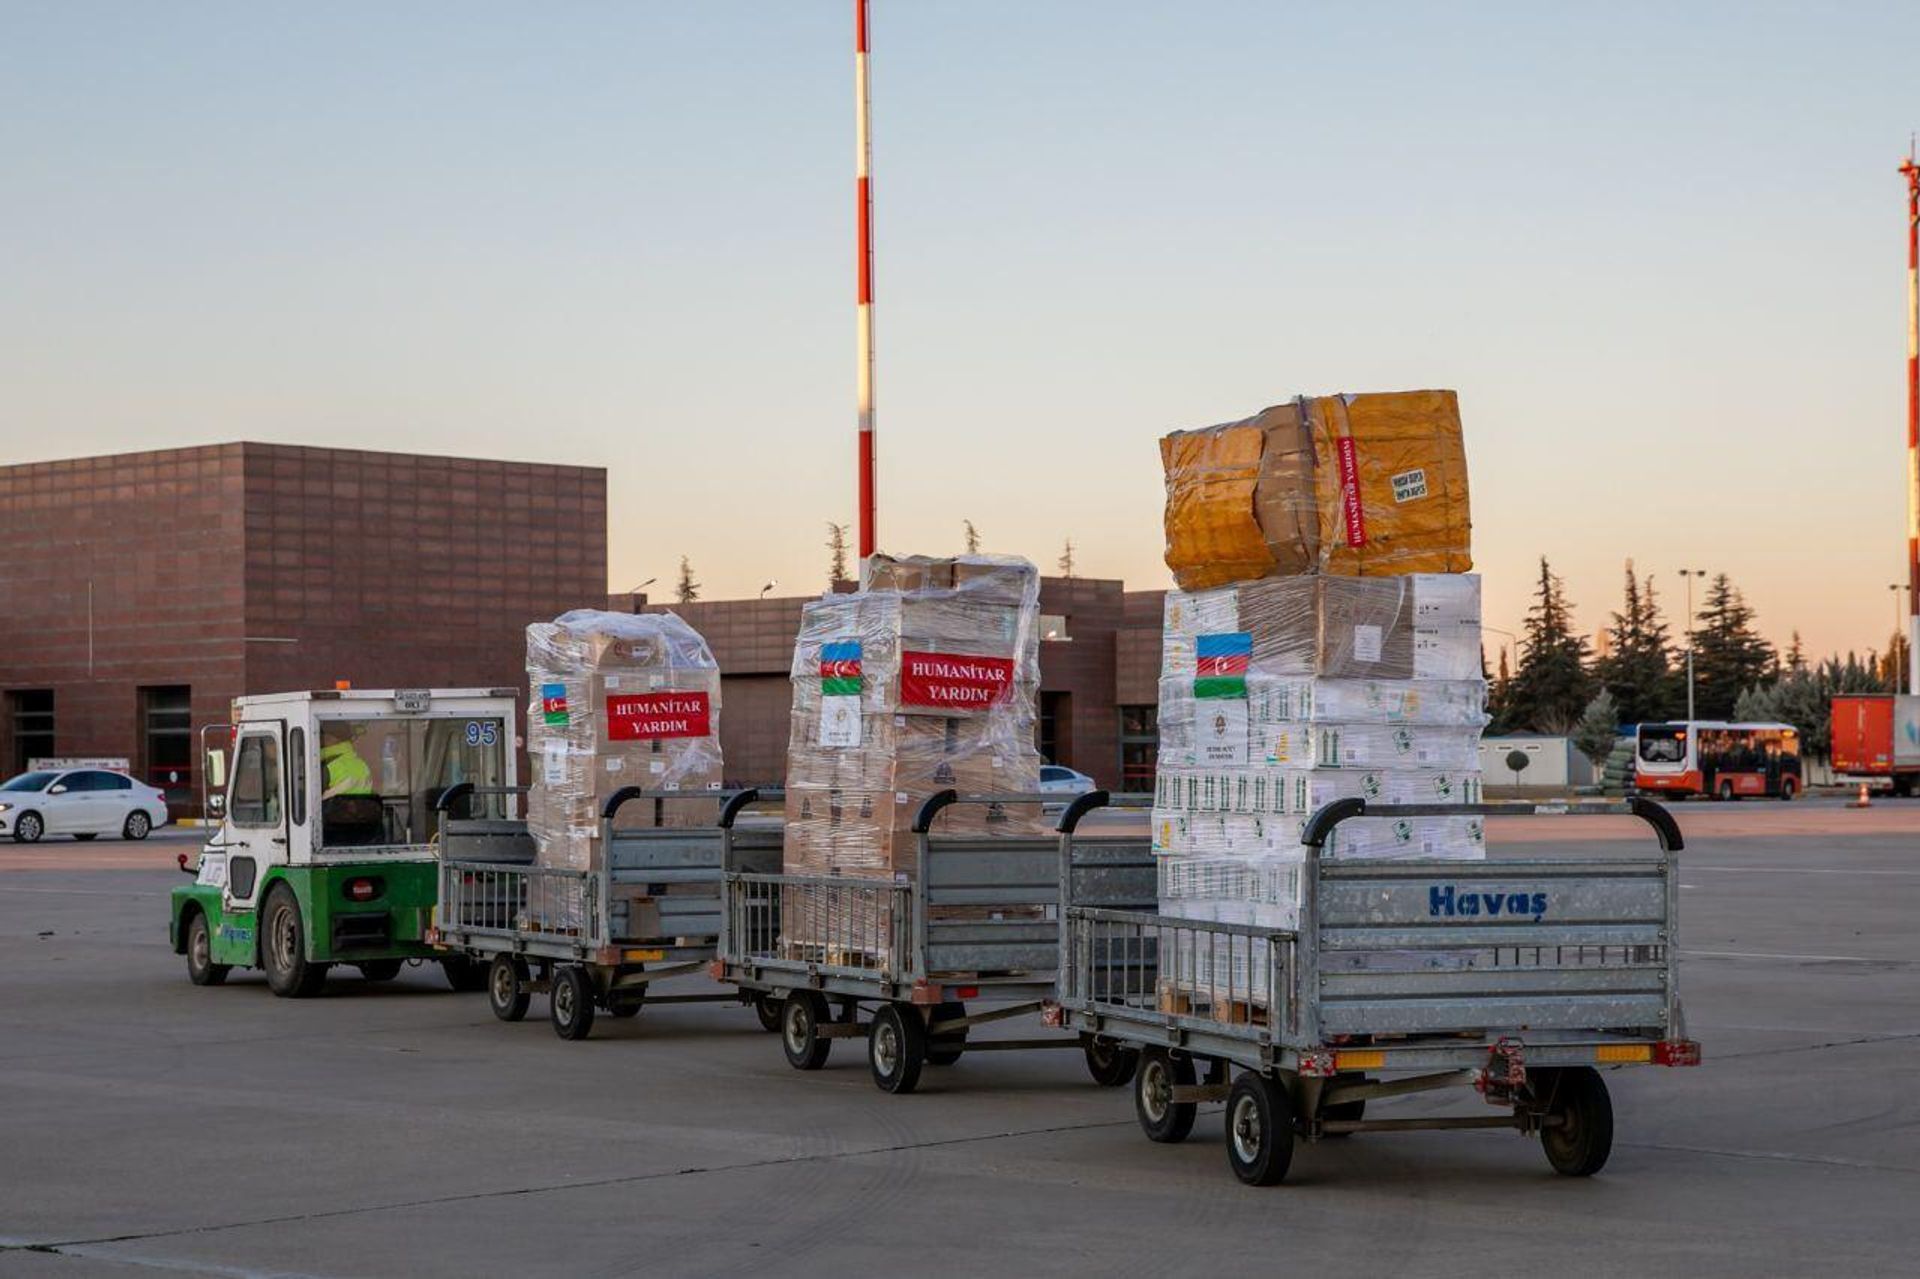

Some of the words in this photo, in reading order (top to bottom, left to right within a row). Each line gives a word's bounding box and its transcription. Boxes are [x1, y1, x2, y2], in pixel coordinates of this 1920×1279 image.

[911, 662, 1006, 681] HUMANİTAR
[928, 684, 988, 702] YARDIM
[616, 700, 702, 715] HUMANİTAR
[466, 721, 498, 746] 95
[632, 720, 688, 734] YARDIM
[1429, 886, 1548, 923] Havaş
